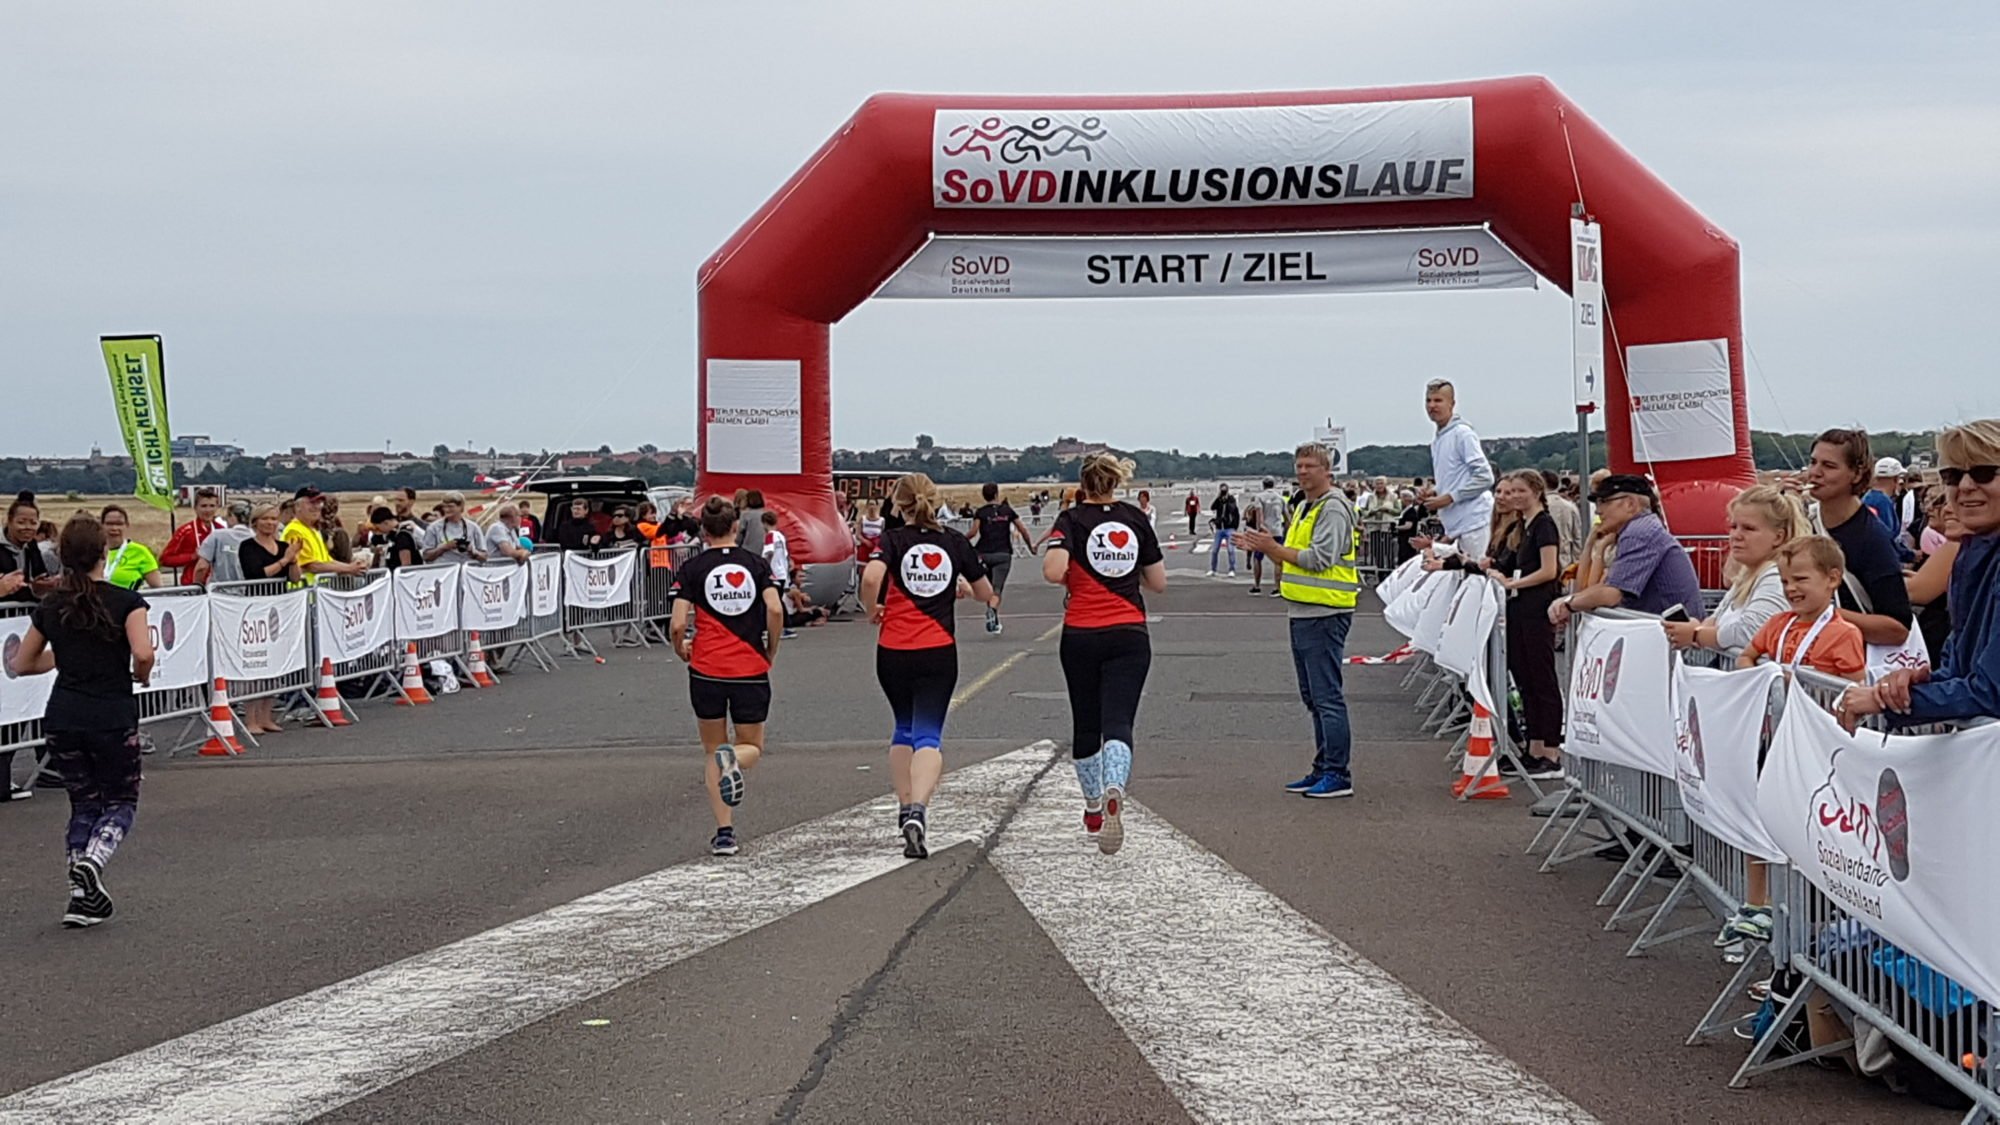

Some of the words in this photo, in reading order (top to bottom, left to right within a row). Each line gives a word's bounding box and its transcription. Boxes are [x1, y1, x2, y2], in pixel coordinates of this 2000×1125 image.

[941, 158, 1465, 204] SoVDINKLUSIONSLAUF
[1418, 247, 1479, 267] SoVD
[951, 256, 1010, 275] SoVD
[1087, 255, 1209, 284] START
[1221, 253, 1232, 284] /
[1243, 252, 1327, 282] ZIEL
[1418, 277, 1480, 286] Deutschland
[951, 286, 1011, 294] Deutschland
[1096, 533, 1106, 548] I
[910, 554, 919, 569] I
[1092, 551, 1135, 561] Vielfalt
[713, 574, 724, 589] I
[906, 572, 948, 581] Vielfalt
[711, 591, 752, 601] Vielfalt
[242, 620, 267, 645] SoVD
